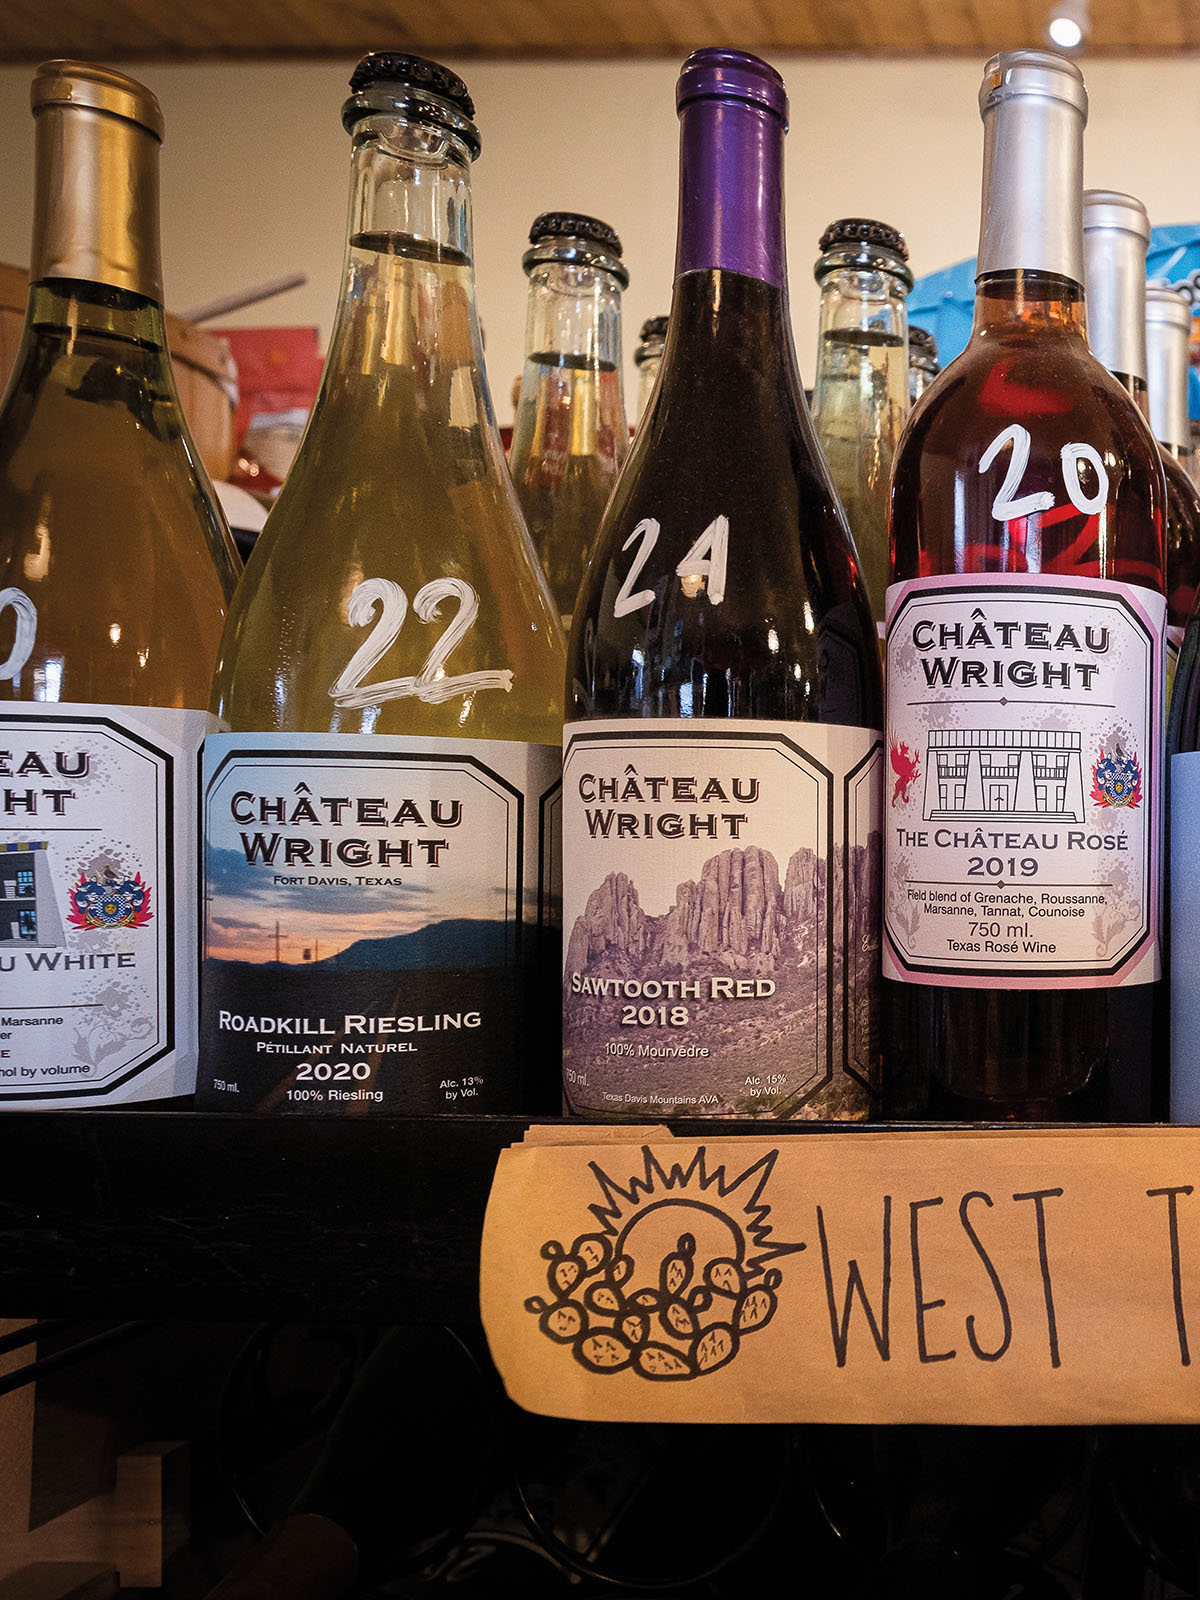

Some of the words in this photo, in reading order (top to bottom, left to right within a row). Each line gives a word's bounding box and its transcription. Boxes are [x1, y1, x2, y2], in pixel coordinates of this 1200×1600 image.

[978, 424, 1109, 521] 20
[613, 514, 731, 619] 24
[912, 607, 1110, 653] CHÂTEAU
[328, 577, 515, 710] 22
[920, 656, 1099, 690] WRIGHT
[579, 764, 760, 803] CHÂTEAU
[231, 782, 463, 828] CHÂTEAU
[584, 809, 748, 839] WRIGHT
[896, 828, 928, 848] THE
[934, 828, 1058, 849] CHÂTEAU
[1067, 831, 1128, 851] ROSÉ
[240, 832, 449, 868] WRIGHT
[967, 857, 1039, 877] 2019
[907, 890, 927, 901] Field
[928, 891, 958, 903] blend
[960, 891, 972, 903] of
[974, 892, 1037, 905] Grenache,
[1041, 893, 1107, 905] Roussanne,
[924, 904, 977, 917] Marsanne,
[981, 905, 1024, 918] Tannat,
[1025, 906, 1085, 917] Counoise
[969, 921, 1001, 937] 750
[1007, 922, 1033, 938] ml.
[947, 940, 980, 952] Texas
[984, 940, 1018, 953] Rosé
[1023, 941, 1056, 953] Wine
[25, 952, 136, 971] WHITE
[571, 973, 700, 998] SAWTOOTH
[711, 977, 776, 998] RED
[1, 1017, 64, 1027] Marsanne
[219, 1010, 336, 1035] ROADKILL
[344, 1012, 482, 1034] RIESLING
[622, 1006, 689, 1026] 2018
[256, 1041, 332, 1054] PÉTILLANT
[341, 1042, 417, 1054] NATUREL
[605, 1043, 634, 1057] 100%
[21, 1066, 37, 1079] by
[40, 1064, 90, 1076] volume
[296, 1063, 371, 1081] 2020
[766, 1074, 787, 1084] 15%
[213, 1079, 226, 1091] 750
[440, 1080, 458, 1089] Alc.
[462, 1076, 484, 1087] 13%
[286, 1090, 323, 1101] 100%
[328, 1089, 384, 1102] Riesling
[445, 1091, 457, 1100] by
[461, 1088, 479, 1098] Vol.
[603, 1092, 622, 1102] Texas
[625, 1094, 647, 1104] Davis
[650, 1095, 696, 1104] Mountains
[699, 1096, 719, 1104] AVA
[750, 1087, 762, 1097] by
[816, 1187, 1064, 1368] WEST
